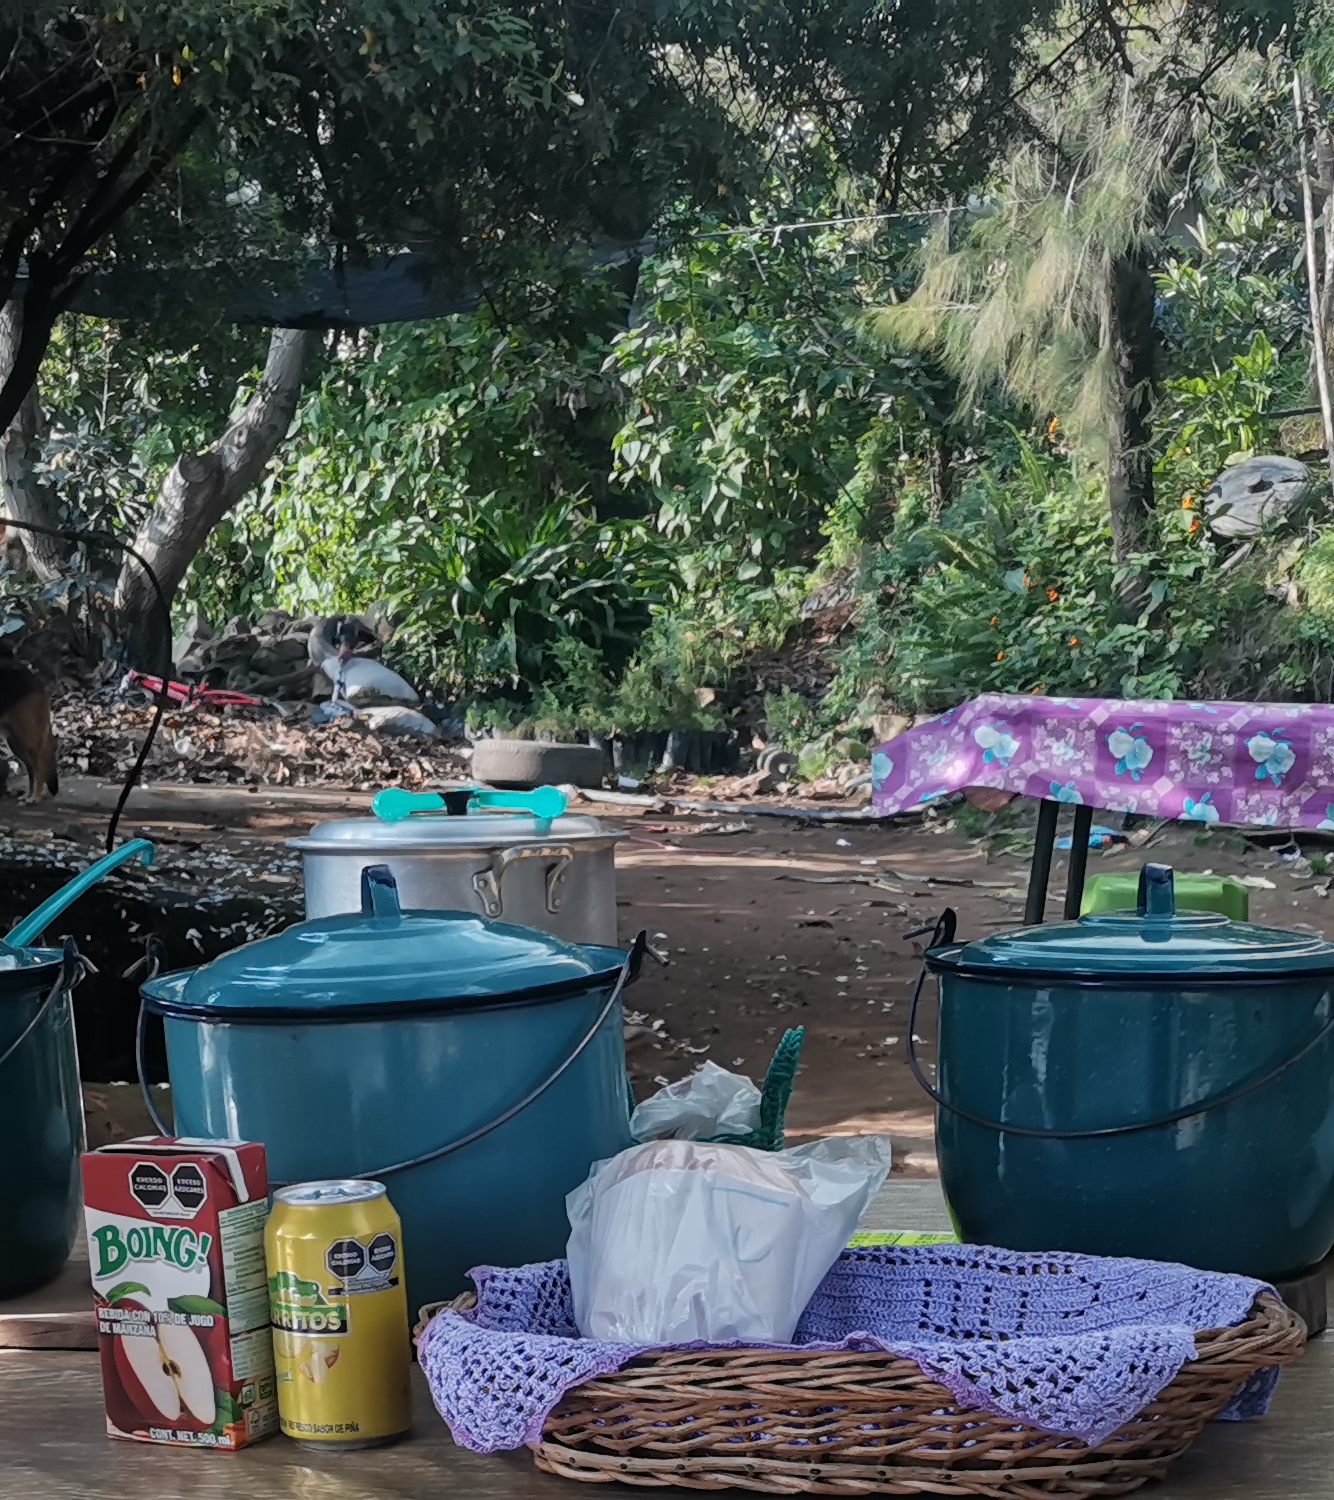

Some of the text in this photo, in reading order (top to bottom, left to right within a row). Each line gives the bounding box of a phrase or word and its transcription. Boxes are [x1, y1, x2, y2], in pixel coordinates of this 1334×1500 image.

[91, 1224, 211, 1277] BOING!
[131, 1309, 151, 1322] CON
[174, 1312, 187, 1325] DE
[99, 1322, 112, 1334] DE
[197, 1432, 217, 1443] 500
